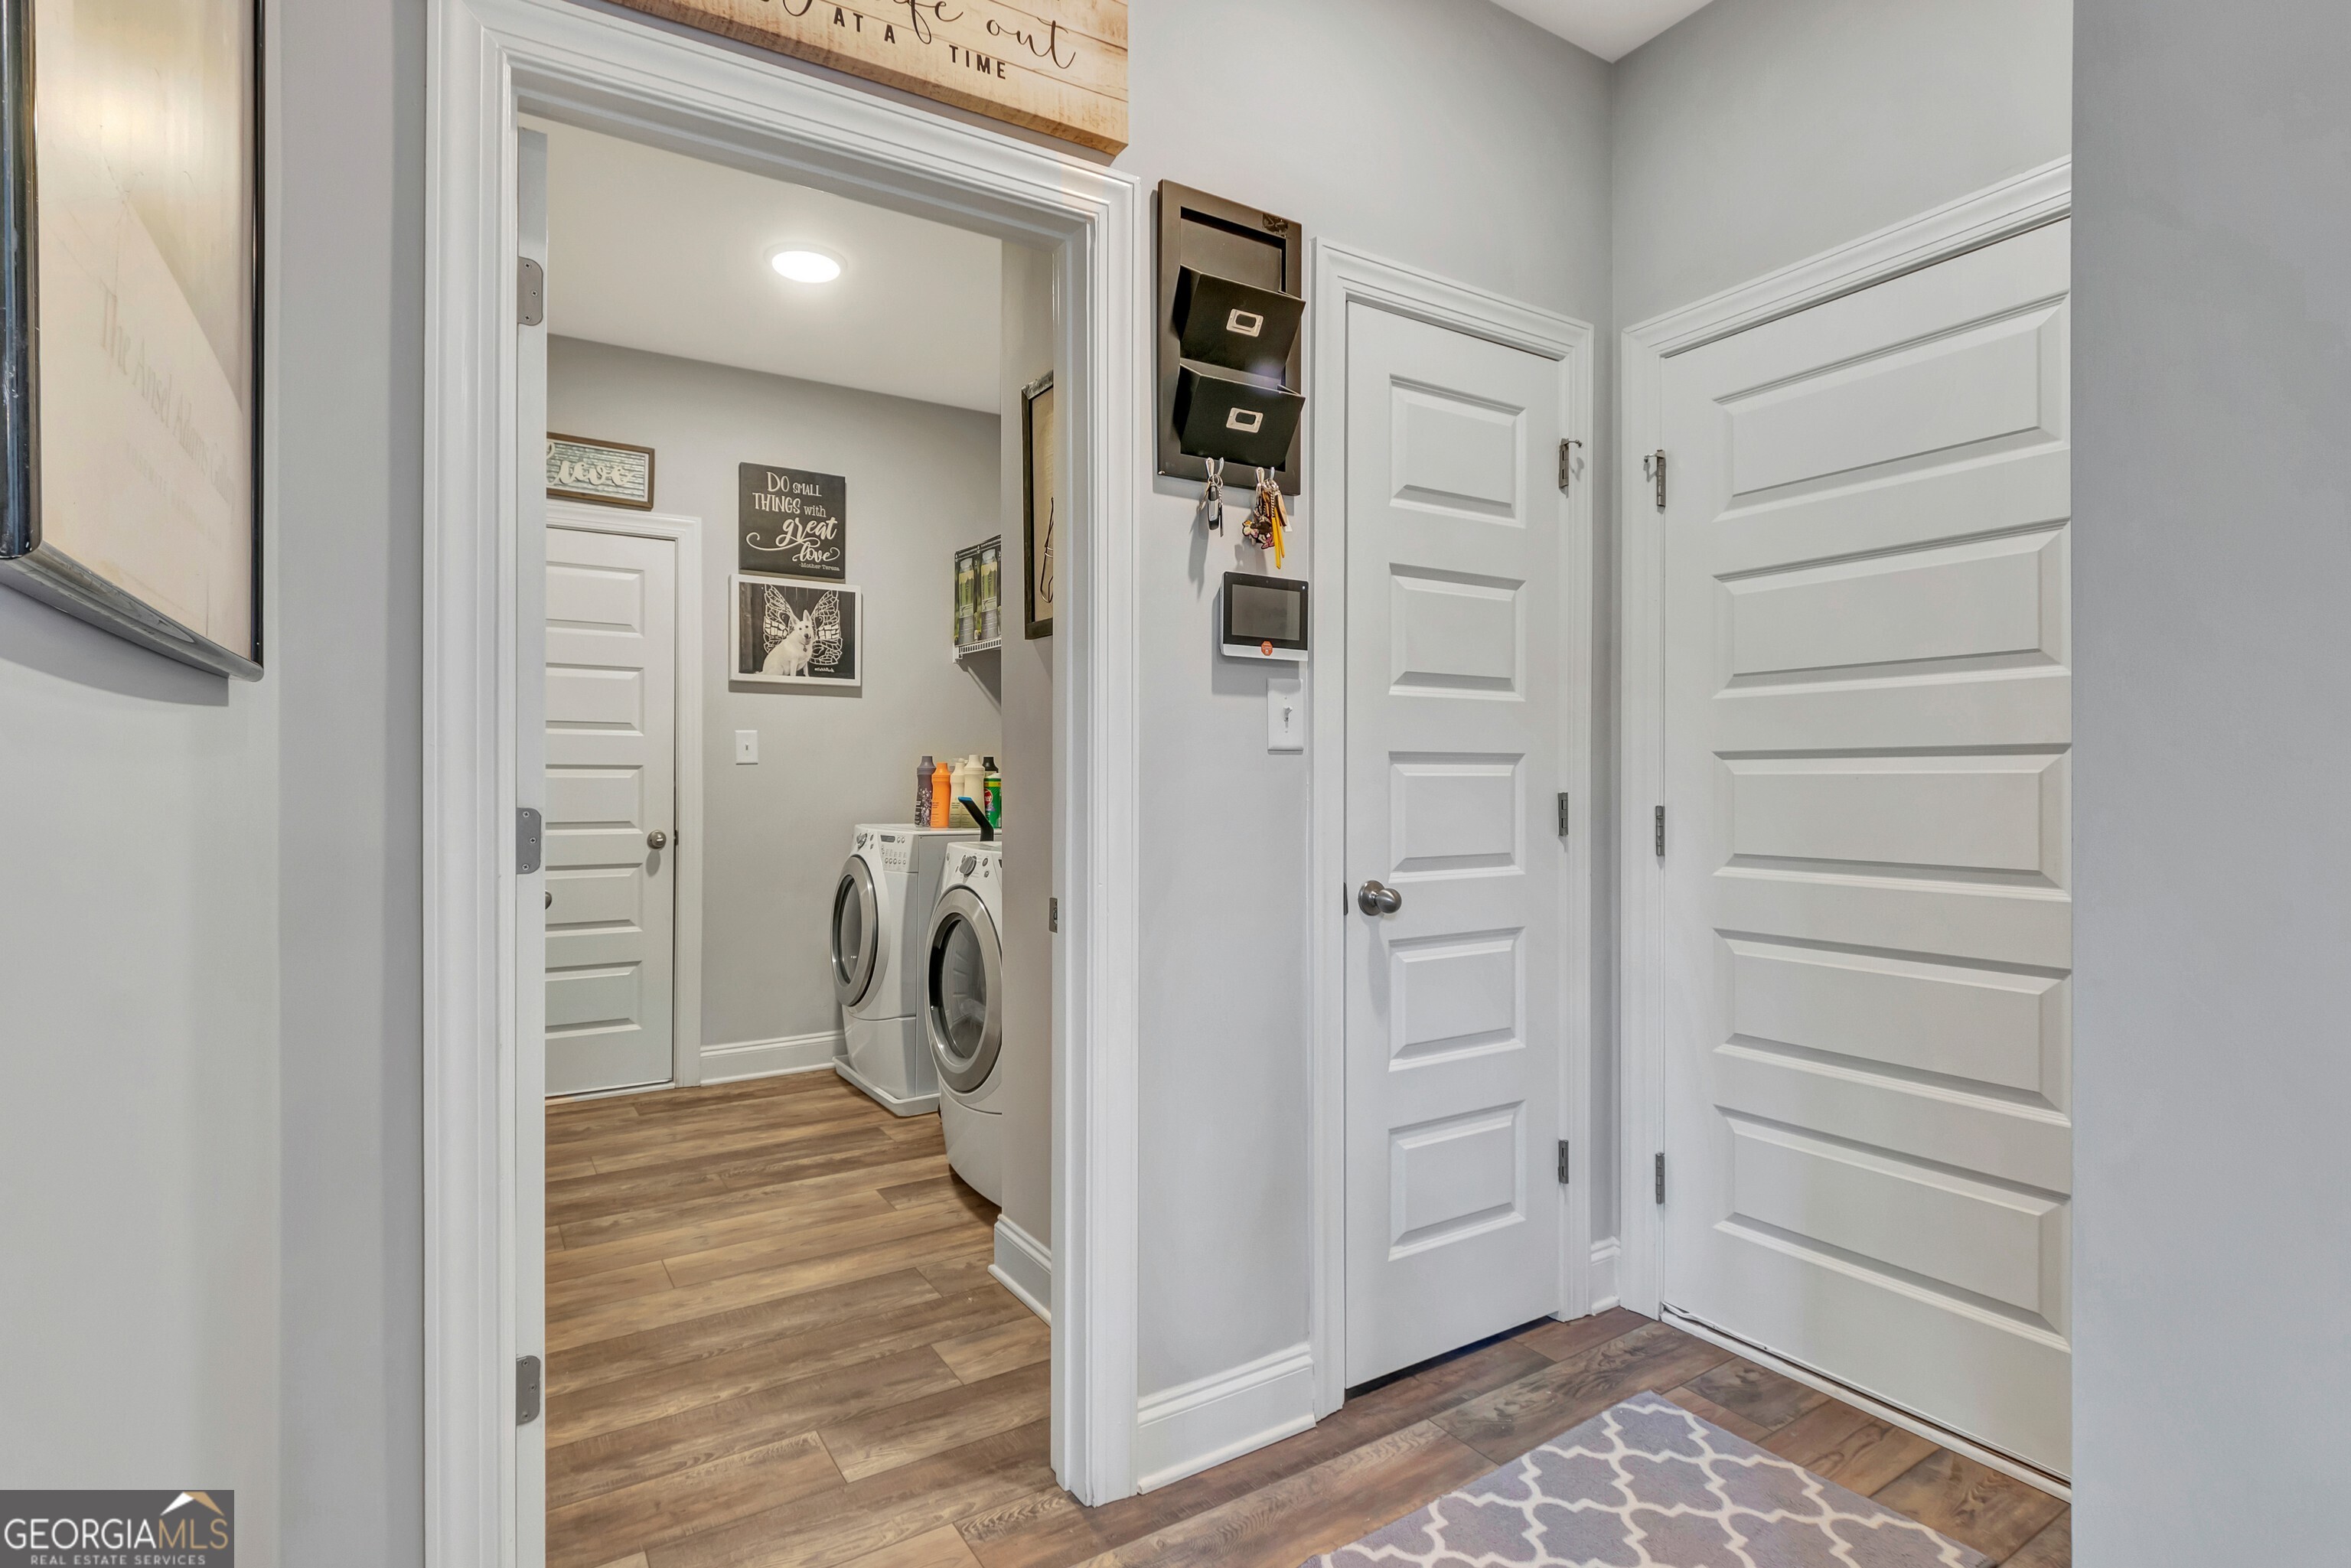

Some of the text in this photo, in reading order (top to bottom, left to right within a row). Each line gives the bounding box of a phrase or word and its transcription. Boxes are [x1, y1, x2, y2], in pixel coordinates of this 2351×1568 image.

[833, 6, 863, 33] AT
[884, 24, 895, 44] A
[949, 44, 1006, 80] TIME
[986, 17, 1076, 70] out
[99, 276, 131, 375] The
[132, 337, 174, 429] Ansel
[766, 471, 823, 497] DO SMALL
[752, 492, 827, 517] THINGS with
[746, 517, 838, 551] great
[791, 541, 841, 562] love
